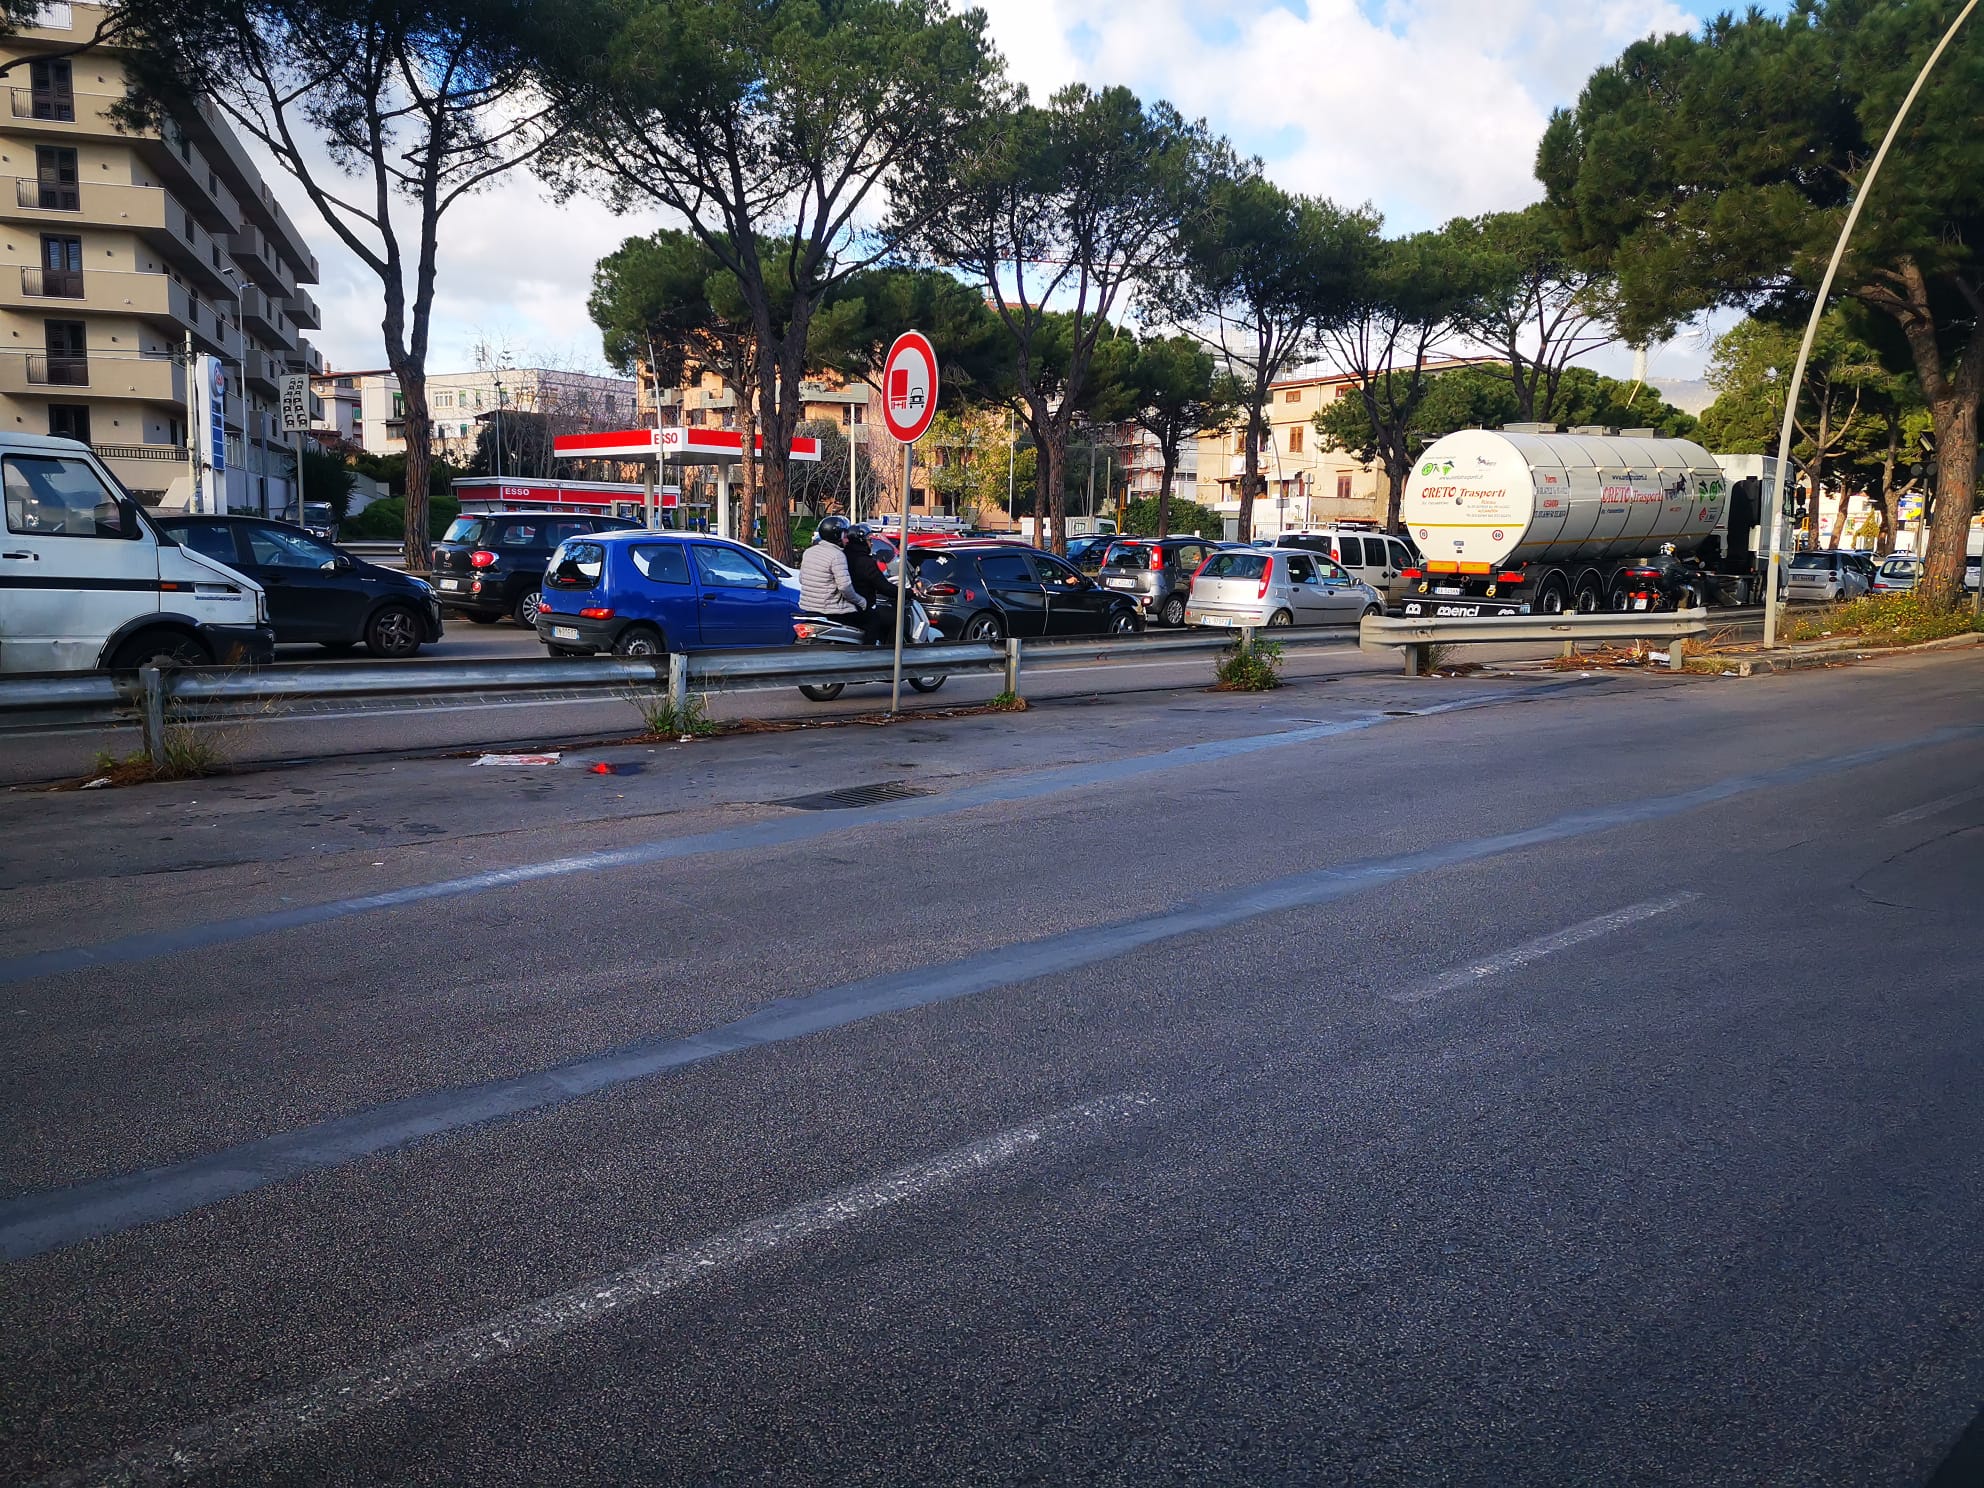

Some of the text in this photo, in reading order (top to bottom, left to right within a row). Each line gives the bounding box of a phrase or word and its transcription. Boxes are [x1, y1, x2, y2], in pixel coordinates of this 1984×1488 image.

[505, 488, 530, 496] ESSO
[1421, 486, 1506, 499] ORETO Trasporti
[1602, 486, 1632, 503] ORETO
